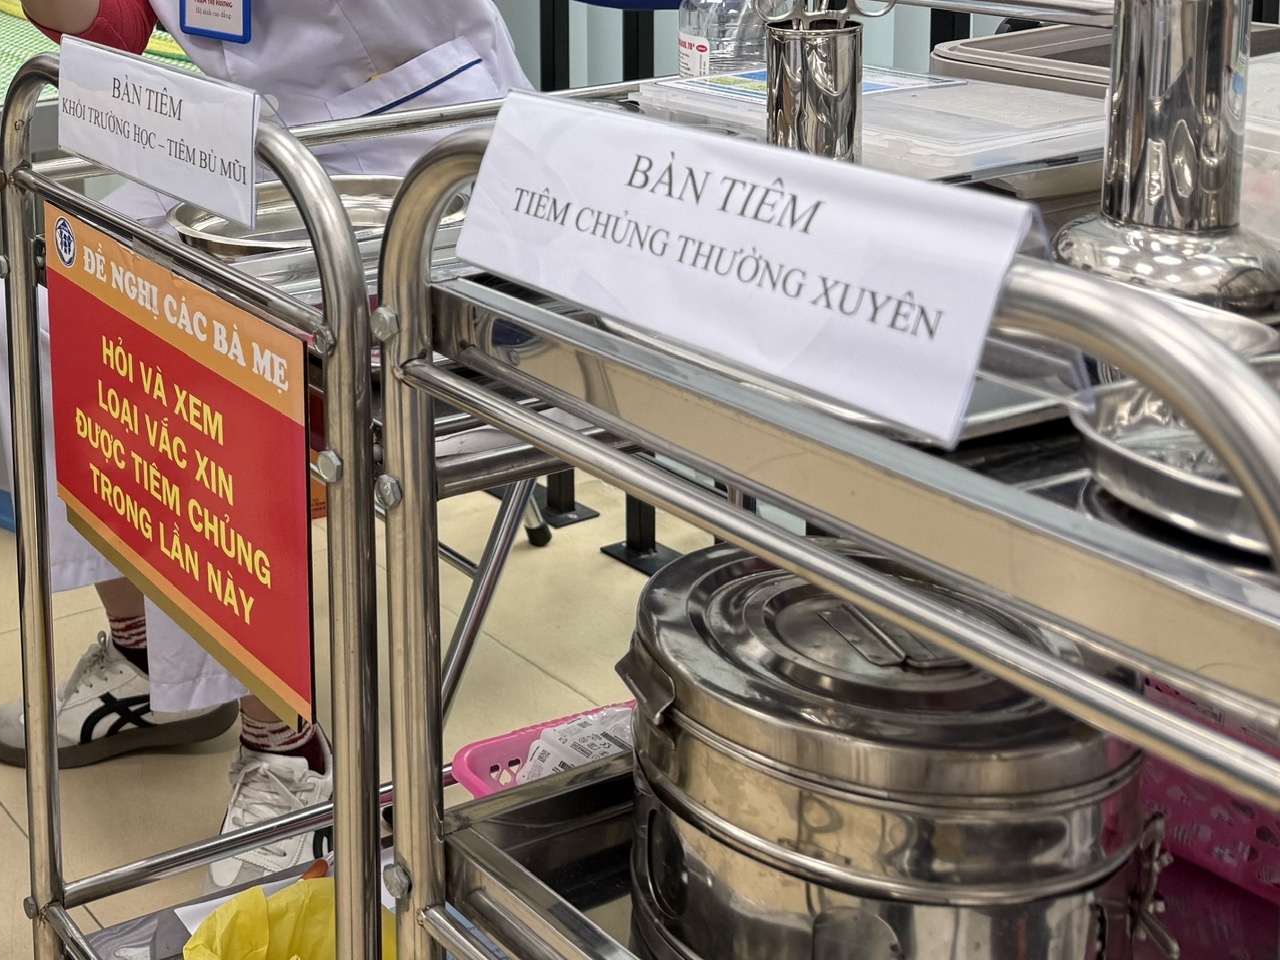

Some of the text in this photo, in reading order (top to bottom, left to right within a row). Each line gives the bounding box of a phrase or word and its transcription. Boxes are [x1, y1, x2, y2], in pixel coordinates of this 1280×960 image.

[62, 97, 86, 121] KHỐI
[88, 107, 130, 139] TRƯỜNG
[133, 123, 156, 149] HỌC
[167, 138, 196, 166] TIÊM
[199, 149, 217, 173] BÙ
[219, 158, 247, 185] MŨI
[112, 74, 183, 121] BÀN TIÊM
[625, 151, 828, 235] BÀN TIÊM
[82, 243, 289, 394] ĐỀ NGHỊ CÁC BÀ MẸ
[513, 187, 946, 342] TIÊM CHỦNG THƯỜNG XUYÊN
[97, 379, 234, 507] LOẠI VẮC XIN
[101, 334, 224, 446] HỎI VÀ XEM
[75, 407, 272, 590] ĐƯỢC TIÊM CHỦNG
[89, 463, 255, 626] TRONG LẦN NÀY
